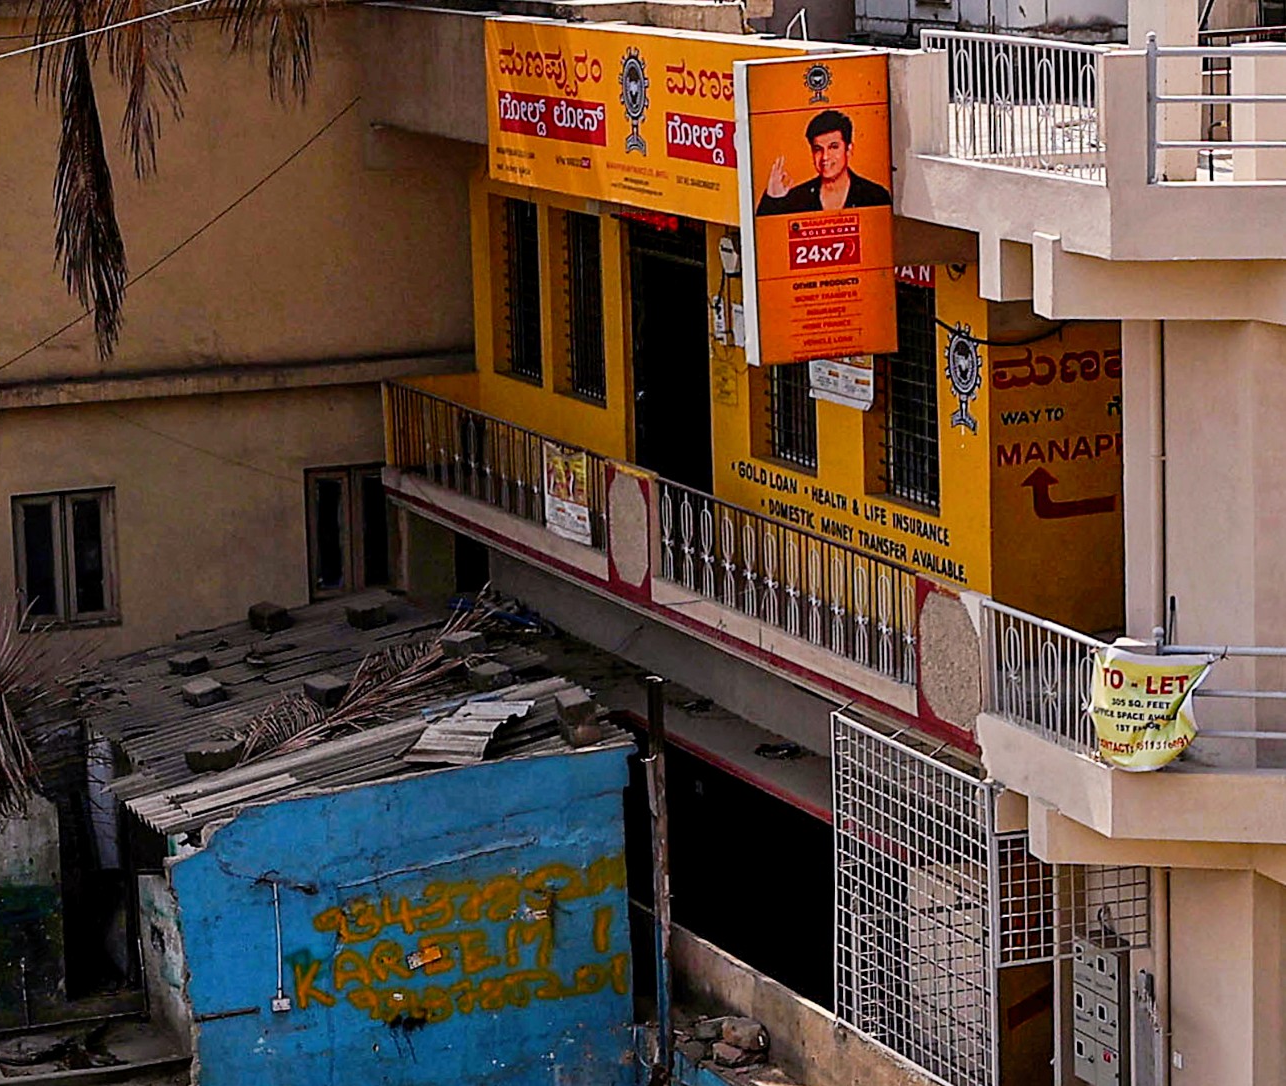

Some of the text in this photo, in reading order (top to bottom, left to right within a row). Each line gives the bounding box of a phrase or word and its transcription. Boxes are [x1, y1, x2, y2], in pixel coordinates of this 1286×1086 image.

[553, 100, 605, 132] ಲೋನ್
[795, 242, 845, 264] 24x7
[792, 277, 859, 290] OTHER PRODUCTS
[1001, 407, 1064, 425] WAY TO
[738, 460, 950, 547] GOLD LOAN HEALTH & LIFE INSURANCE
[768, 498, 816, 530] DOMESTIC
[821, 516, 854, 542] MONEY
[858, 529, 907, 559] TRANSFER
[1102, 667, 1124, 690] TO
[1145, 675, 1189, 695] LET
[1117, 711, 1144, 721] SPACE
[1128, 699, 1144, 709] SQ.
[1146, 701, 1171, 710] FEET
[292, 920, 555, 1010] KAREEM
